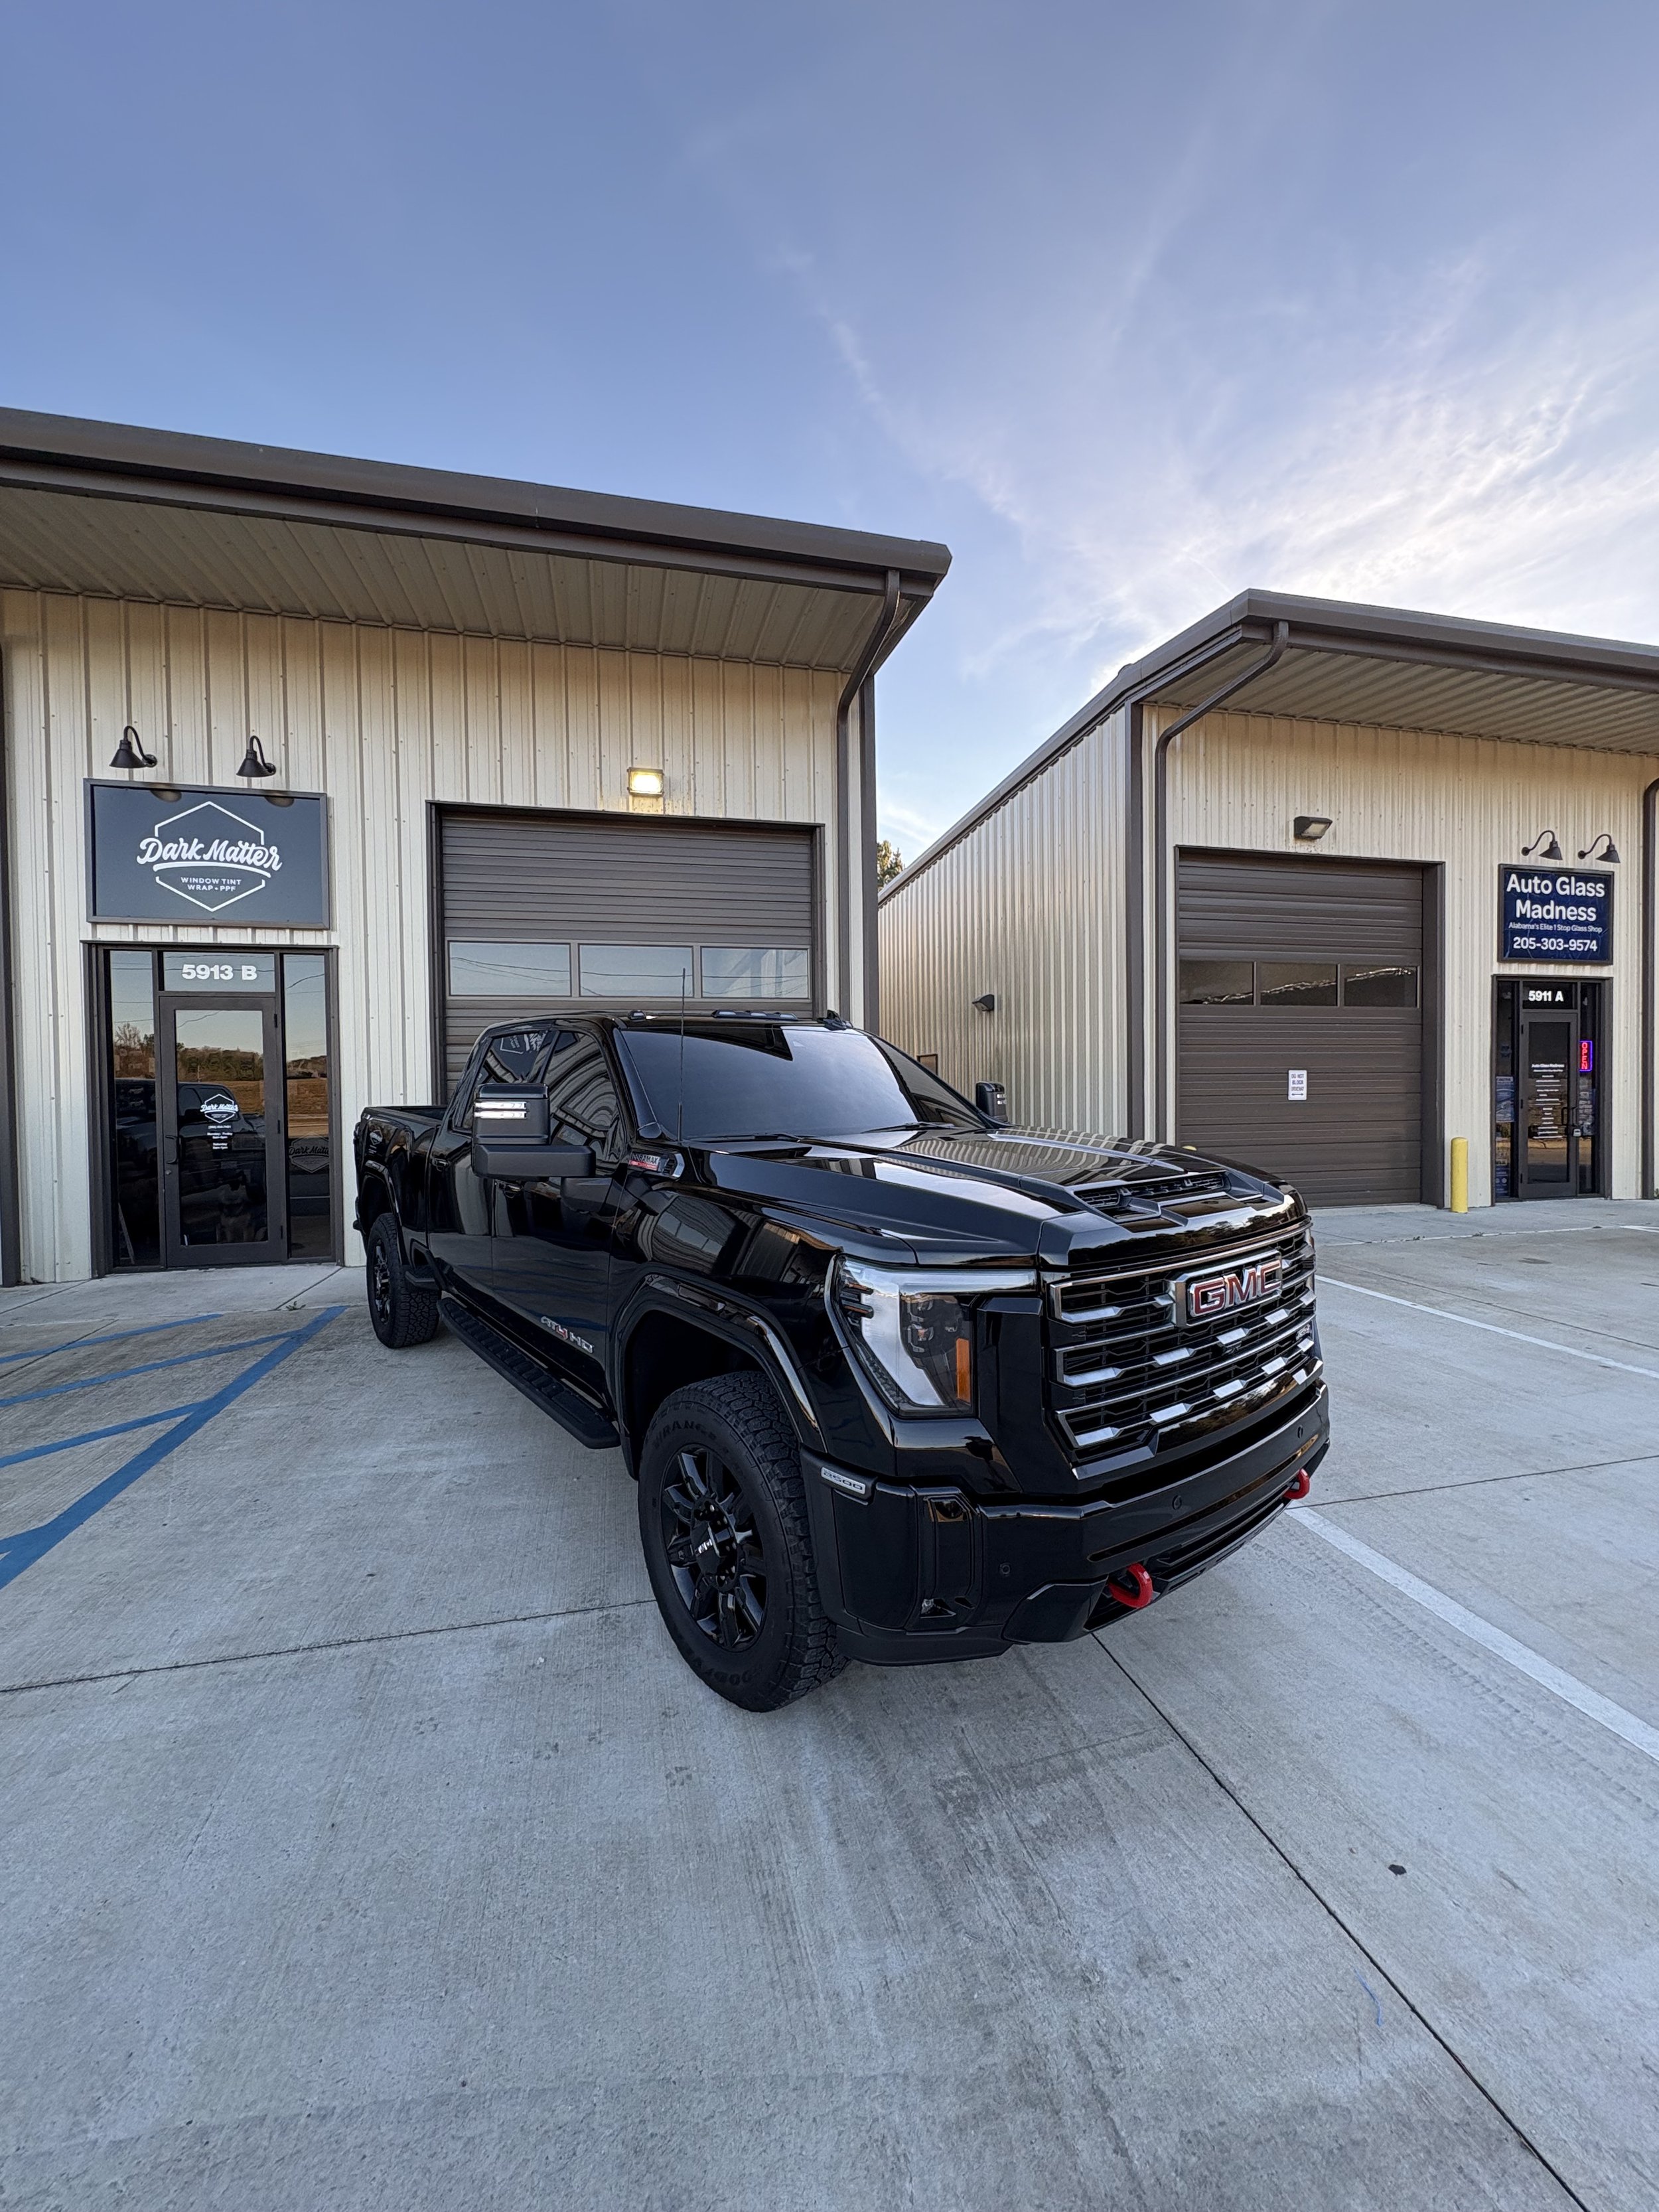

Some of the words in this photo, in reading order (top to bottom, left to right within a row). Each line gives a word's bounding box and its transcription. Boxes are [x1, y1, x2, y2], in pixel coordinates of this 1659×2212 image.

[137, 838, 204, 864] Dark
[203, 839, 282, 871] Matter
[1506, 873, 1552, 895] Auto
[1555, 876, 1605, 897] Glass
[1516, 899, 1597, 921] Madness
[1557, 924, 1570, 932] Stop
[1513, 936, 1597, 952] 205-303-9574
[181, 964, 234, 980] 5913
[242, 964, 257, 980] B
[1528, 990, 1551, 1001] 5911
[1555, 991, 1564, 1001] A
[200, 1104, 218, 1112] Dark
[1189, 1259, 1281, 1317] GMC
[541, 1316, 568, 1340] AT4
[569, 1331, 593, 1353] HD
